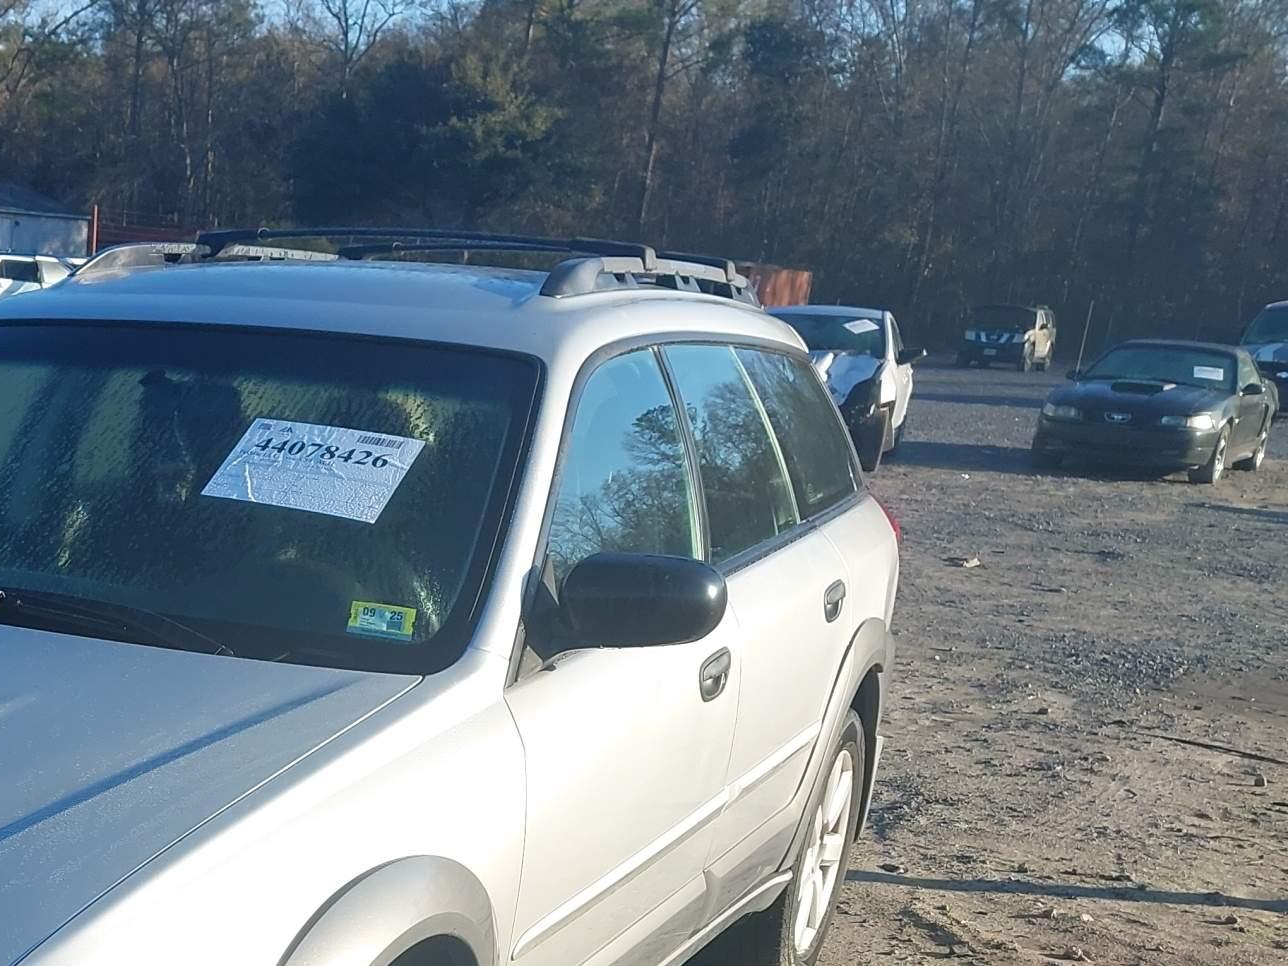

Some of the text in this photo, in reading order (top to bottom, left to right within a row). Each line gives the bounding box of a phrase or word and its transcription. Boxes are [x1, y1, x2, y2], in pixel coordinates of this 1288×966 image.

[255, 438, 393, 469] 44078426
[362, 606, 404, 621] 09 25
